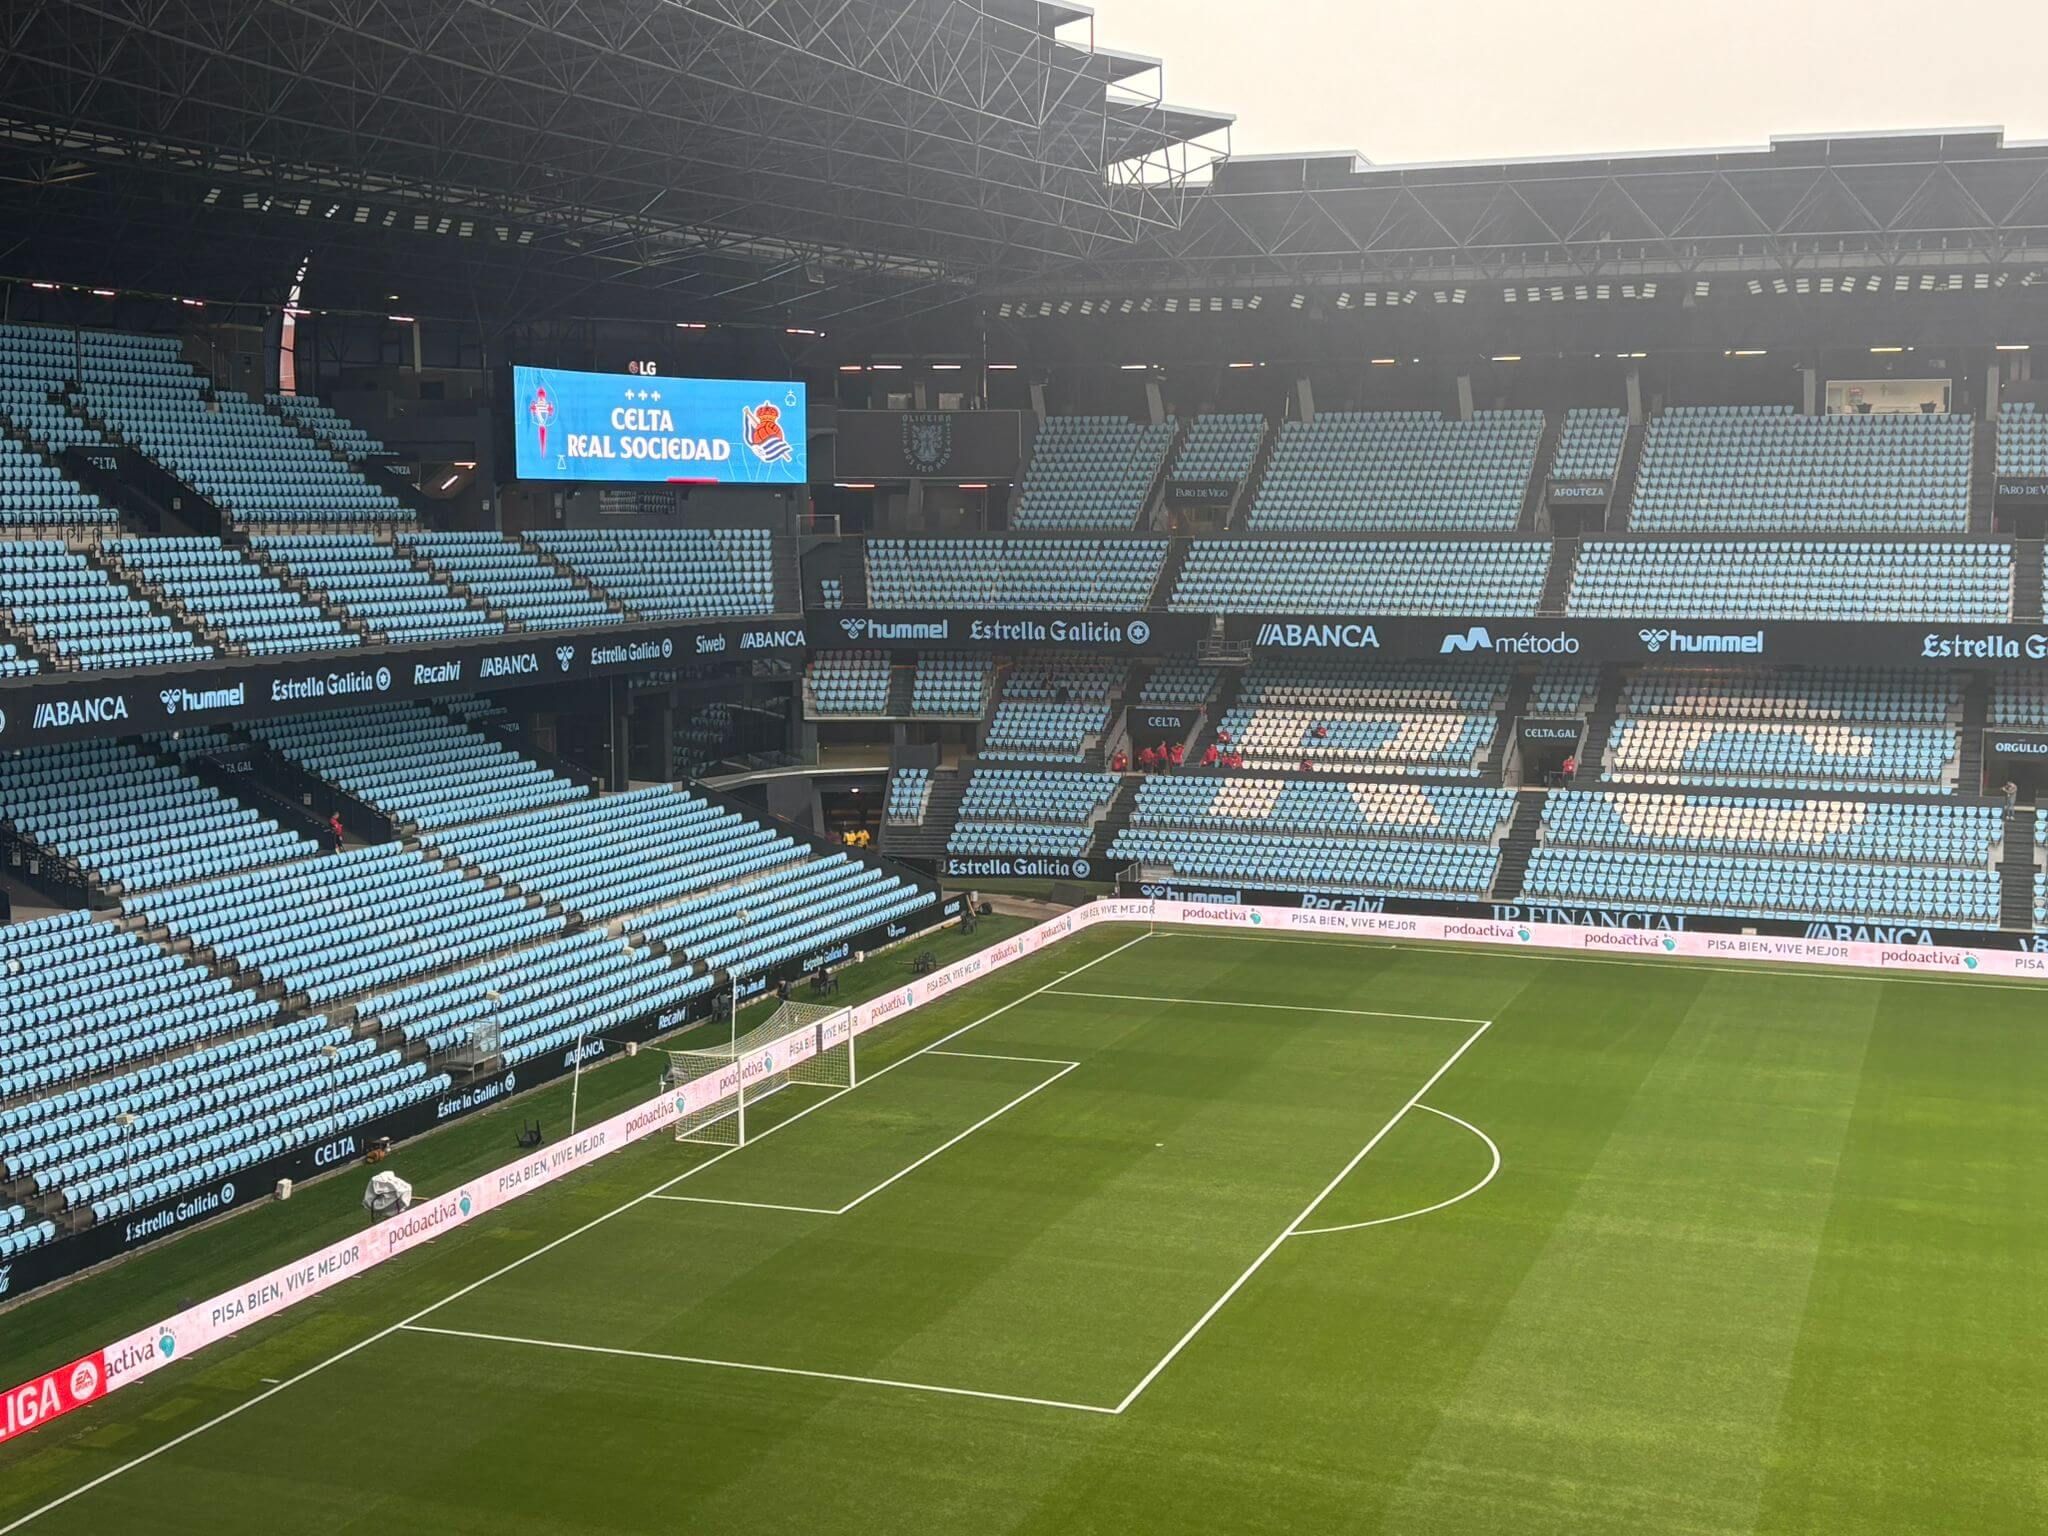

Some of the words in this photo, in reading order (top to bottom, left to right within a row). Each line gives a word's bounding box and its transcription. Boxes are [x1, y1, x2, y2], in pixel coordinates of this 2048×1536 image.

[640, 361, 657, 376] LG
[611, 407, 674, 432] CELTA
[567, 434, 616, 459] REAL
[620, 436, 731, 461] SOCIEDAD
[867, 618, 949, 640] hummel
[969, 619, 1046, 641] Estrella
[1050, 619, 1122, 643] Galicia
[695, 635, 726, 654] Siweb
[1495, 631, 1580, 654] método
[1670, 629, 1764, 654] hummel
[1921, 633, 2020, 659] Estrella
[2025, 634, 2048, 659] G
[590, 643, 628, 665] Estrella
[628, 641, 661, 661] Galicia
[413, 660, 461, 685] Recalvi
[271, 673, 325, 701] Estrella
[326, 671, 373, 696] Galicia
[181, 683, 245, 712] hummel
[1148, 716, 1181, 728] CELTA
[1524, 727, 1578, 740] CELTA.GAL
[1994, 742, 2048, 754] ORGULLO
[948, 859, 1012, 877] Estrella
[1013, 858, 1070, 878] Galicia
[1166, 886, 1242, 905] hummel
[1301, 894, 1385, 914] Recalvi
[1120, 904, 1156, 914] MEJOR
[1182, 907, 1247, 920] podoactiva
[1291, 913, 1317, 926] PISA
[1319, 915, 1349, 929] BIEN,
[1350, 917, 1376, 929] VIVE
[1378, 918, 1416, 931] MEJOR
[1443, 921, 1515, 938] podoactiva
[1584, 932, 1660, 947] podoactiva
[1707, 939, 1736, 951] PISA
[1738, 940, 1772, 954] BIEN,
[1774, 942, 1803, 955] VIVE
[1805, 944, 1849, 957] MEJOR
[1881, 949, 1961, 966] podoactiva
[2015, 958, 2045, 970] PISA
[625, 1101, 675, 1141] podoactiva
[314, 1135, 356, 1167] CELTA
[498, 1172, 523, 1193] PISA
[523, 1158, 552, 1185] BIEN,
[551, 1148, 574, 1168] VIVE
[574, 1131, 606, 1161] MEJOR
[176, 1192, 219, 1222] Galicia
[388, 1197, 457, 1254] podoactiva
[212, 1298, 245, 1327] PISA
[247, 1280, 284, 1310] BIEN,
[286, 1261, 316, 1293] VIVE
[317, 1245, 360, 1279] MEJOR
[105, 1337, 156, 1380] activa
[75, 1369, 93, 1387] EA
